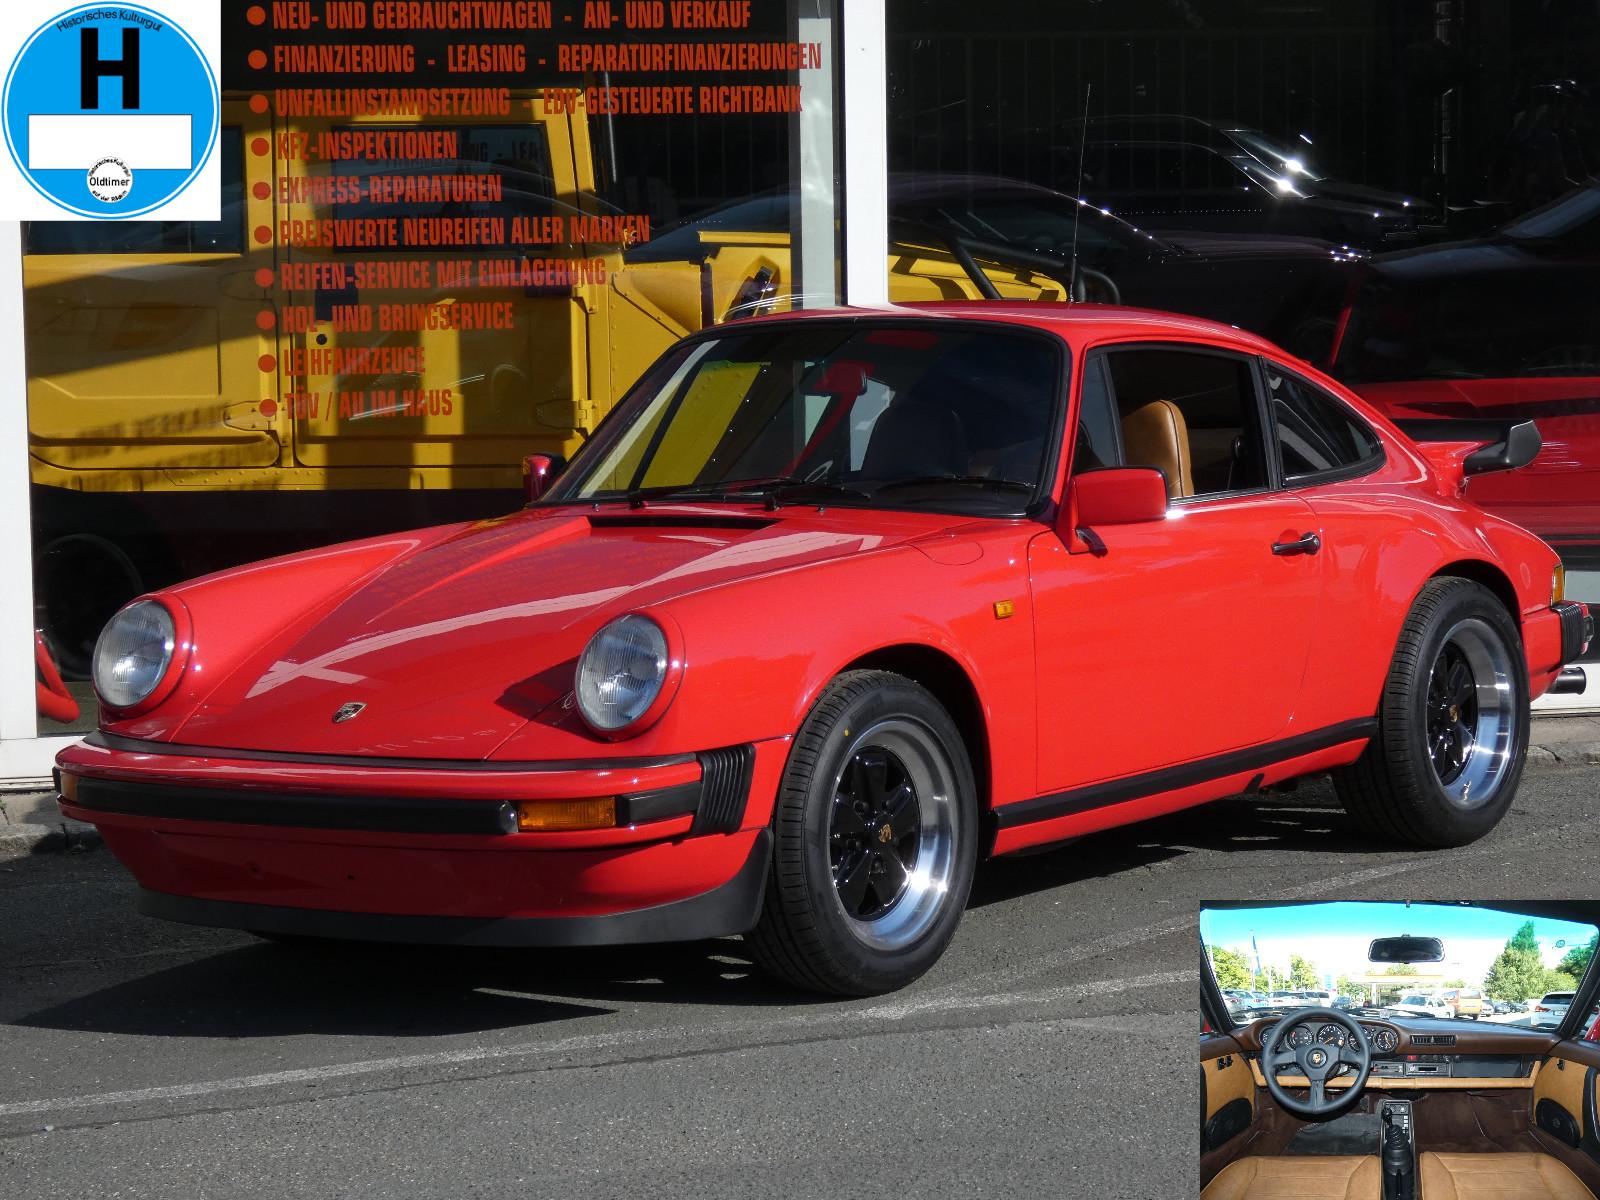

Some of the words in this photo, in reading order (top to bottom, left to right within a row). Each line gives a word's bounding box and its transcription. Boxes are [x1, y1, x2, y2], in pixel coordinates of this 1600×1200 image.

[273, 2, 319, 29] NEU-
[326, 2, 366, 29] UND
[373, 2, 551, 29] GEBRAUCHTWAGEN
[584, 1, 619, 29] AN-
[626, 1, 664, 28] UND
[671, 1, 751, 28] VERKAUF
[274, 45, 415, 73] FINANZIERUNG
[448, 44, 526, 72] LEASING
[559, 43, 822, 72] REPARATURFINANZIERUNGEN
[275, 88, 511, 117] UNFALLINSTANDSETZUNG
[543, 86, 693, 115] EDV-GESTEUERTE
[700, 85, 803, 113] RICHTBANK
[277, 131, 457, 160] KFZ-INSPEKTIONEN
[279, 175, 502, 204] EXPRESS-REPARATUREN
[280, 220, 397, 247] PREISWERTE
[403, 218, 504, 246] NEUREIFEN
[511, 217, 563, 245] ALLER
[571, 215, 650, 243] MARKEN
[281, 261, 431, 290] REIFEN-SERVICE
[437, 260, 470, 288] MIT
[478, 258, 607, 287] EINLAGERUNG
[282, 304, 326, 333] HOL-
[332, 304, 372, 332] UND
[379, 302, 514, 331] BRINGSERVICE
[284, 347, 426, 376] LEIHFAHRZEUGE
[284, 385, 319, 420] TÜV
[370, 389, 396, 418] IM
[402, 389, 452, 417] HAUS
